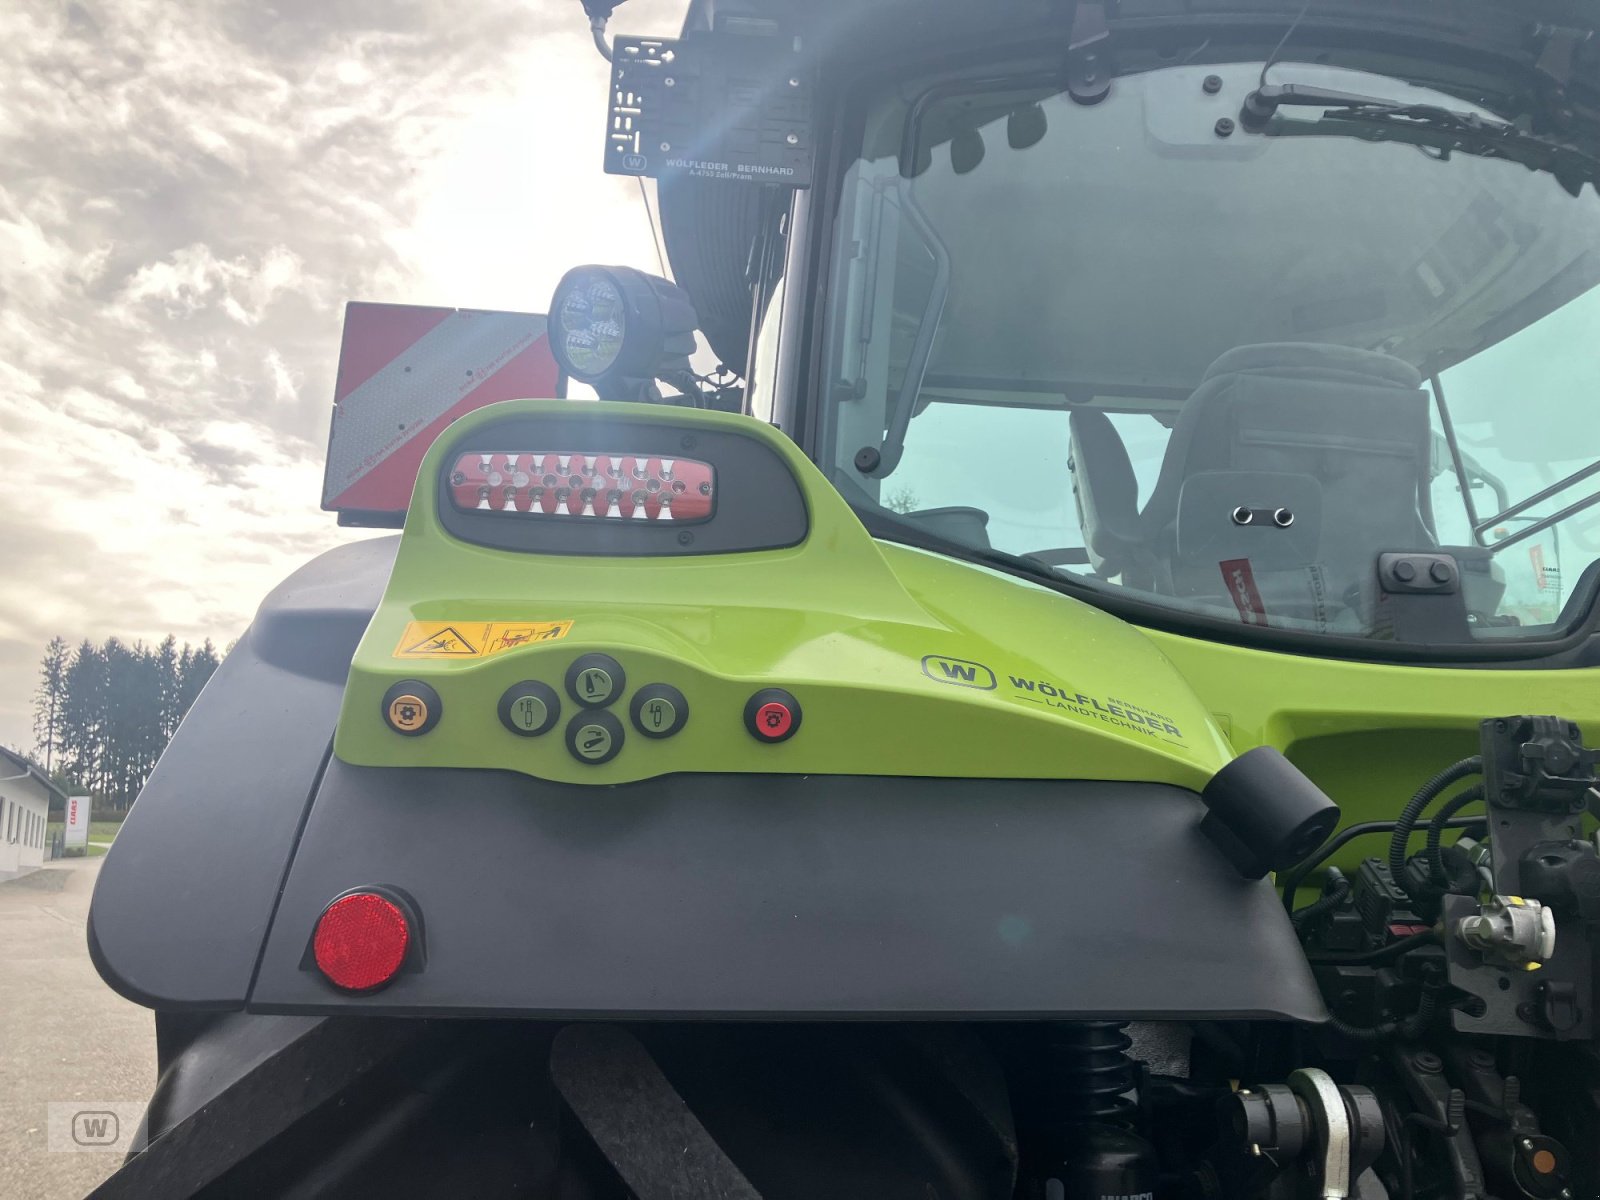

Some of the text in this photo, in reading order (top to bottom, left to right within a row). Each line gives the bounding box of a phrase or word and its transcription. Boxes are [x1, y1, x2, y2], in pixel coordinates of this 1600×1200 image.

[629, 157, 642, 167] W
[665, 158, 794, 175] WÖLFLEDER BERNHARD
[939, 661, 976, 682] W
[1008, 675, 1183, 738] WÖLFLEDER
[1045, 698, 1157, 737] LANDTECHNIK
[1107, 697, 1174, 724] BERNHARD
